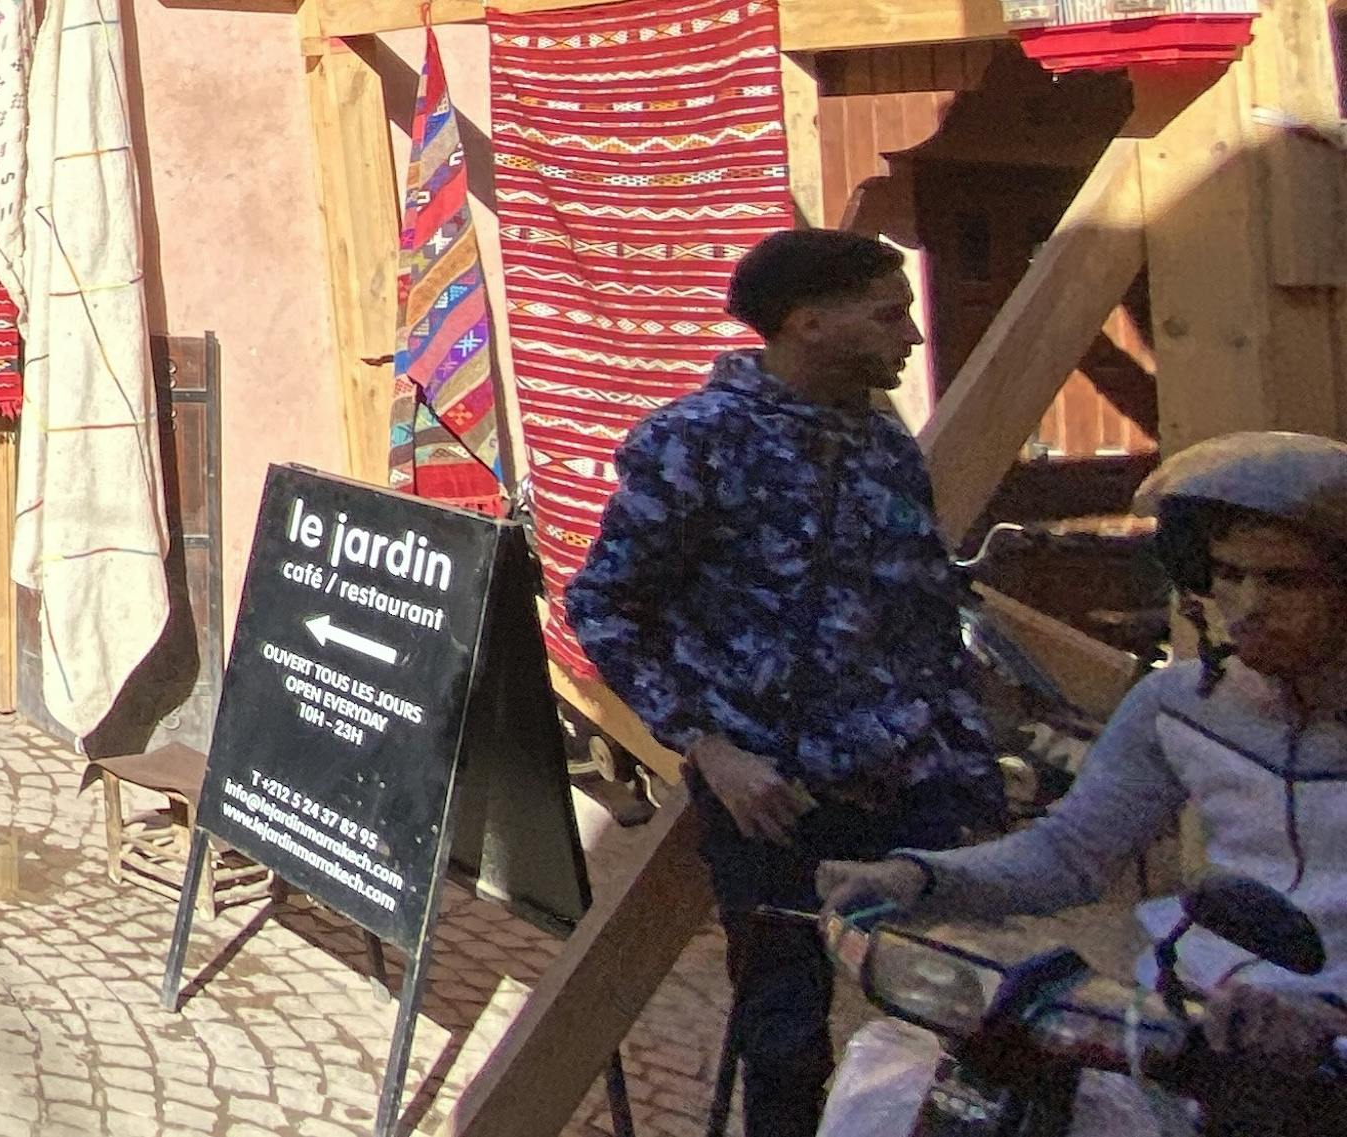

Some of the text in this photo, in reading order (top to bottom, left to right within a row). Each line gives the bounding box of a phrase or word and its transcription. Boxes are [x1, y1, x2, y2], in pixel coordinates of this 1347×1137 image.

[289, 498, 452, 591] le jardin
[283, 562, 323, 589] café
[340, 580, 445, 630] restaurant
[263, 643, 424, 724] OUVERT TOUS LES JOURS
[285, 675, 389, 732] OPEN EVERYDAY
[299, 702, 325, 727] 10H
[334, 720, 363, 745] 23H
[224, 778, 404, 891] info@lejardinmarrakech.com
[252, 769, 379, 850] T +212 5 24 37 82 95
[223, 803, 396, 912] www.lejardinmarrakech.com
